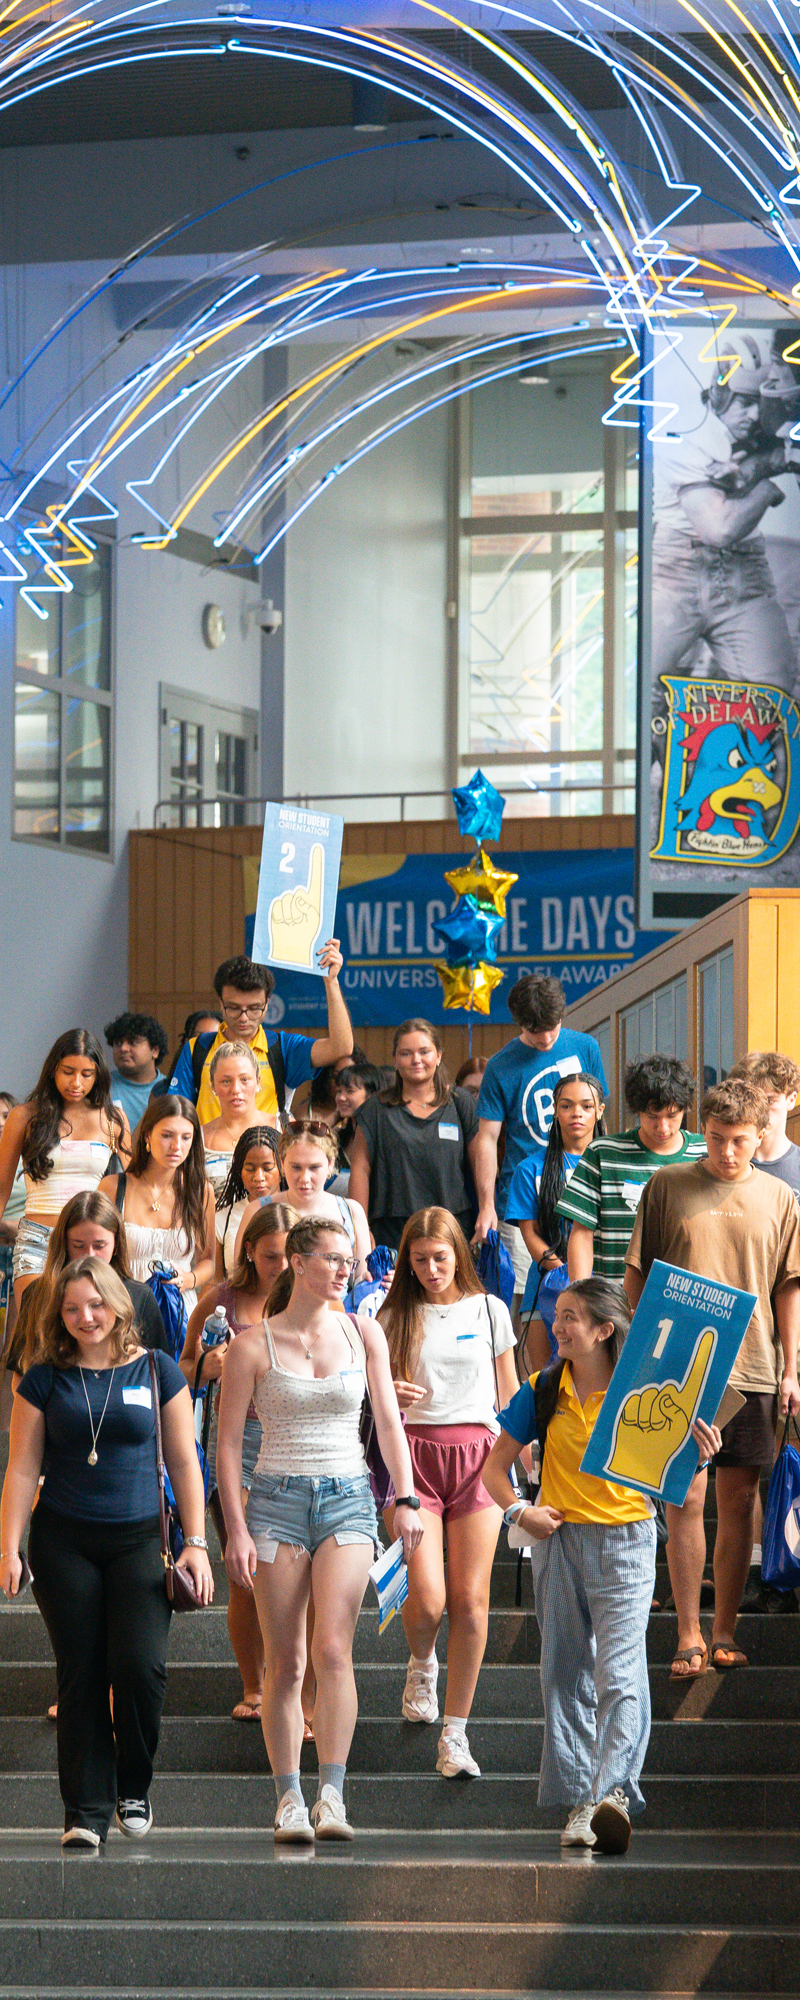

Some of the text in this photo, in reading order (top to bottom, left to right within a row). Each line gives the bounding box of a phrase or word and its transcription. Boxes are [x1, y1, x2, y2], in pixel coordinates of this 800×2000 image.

[665, 684, 800, 716] UNIVERSIT
[651, 703, 800, 741] OF DELAWA
[278, 820, 330, 838] ORIENTATION
[279, 808, 331, 829] NEW STUDENT
[279, 841, 296, 874] 2
[345, 895, 636, 956] WELCE DAYS
[344, 966, 443, 989] UNIVERS
[517, 963, 633, 986] DELAWAR
[663, 1288, 732, 1320] ORIENTATION
[666, 1272, 738, 1310] NEW STUDENT
[652, 1317, 674, 1360] 1
